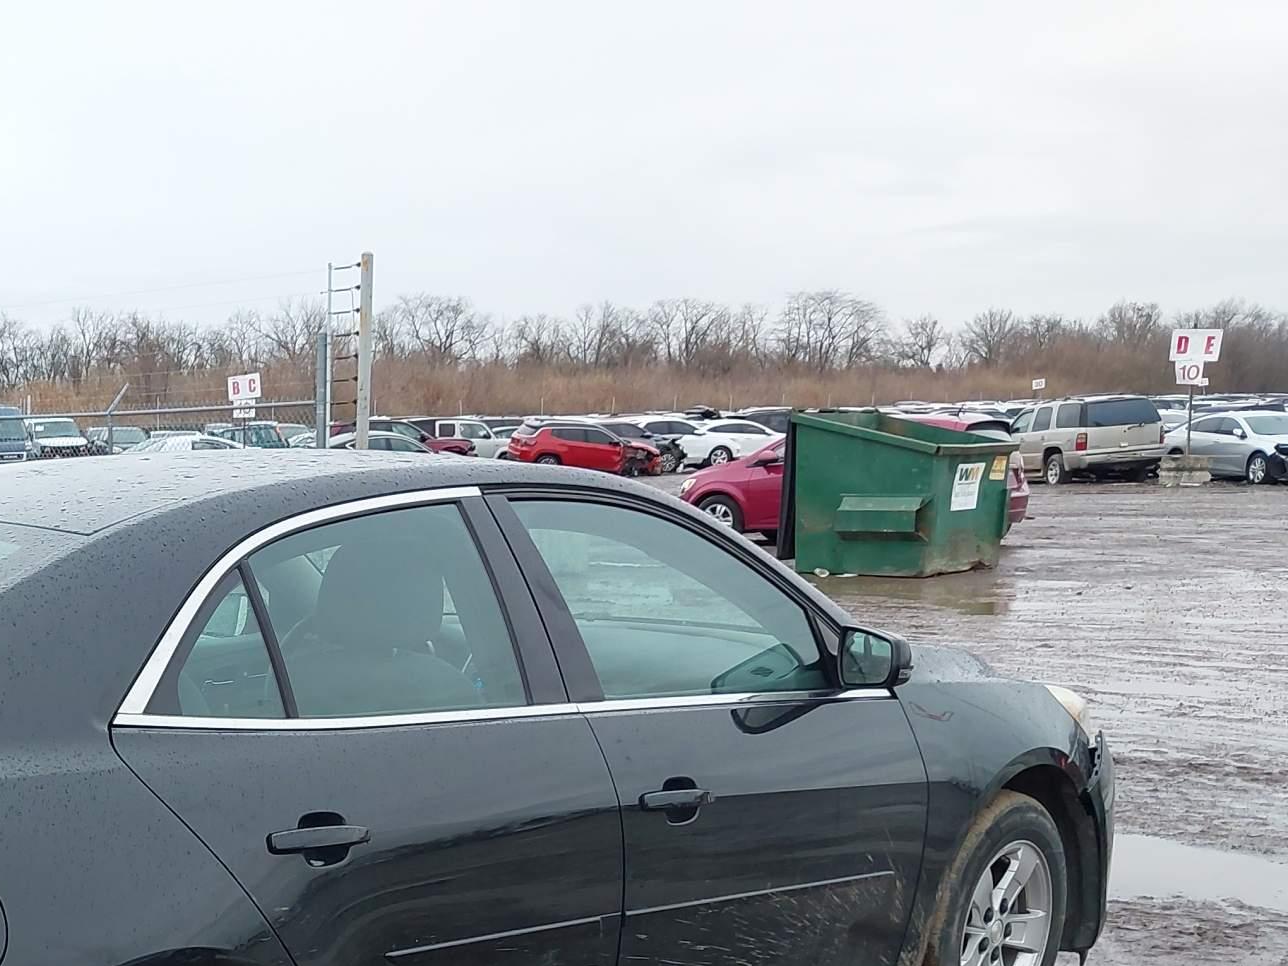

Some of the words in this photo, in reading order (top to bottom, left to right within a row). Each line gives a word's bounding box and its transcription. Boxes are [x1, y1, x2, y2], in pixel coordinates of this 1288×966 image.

[1176, 335, 1190, 355] D
[1204, 335, 1216, 355] E
[1179, 364, 1201, 381] 10
[232, 381, 241, 395] B
[248, 378, 257, 393] C
